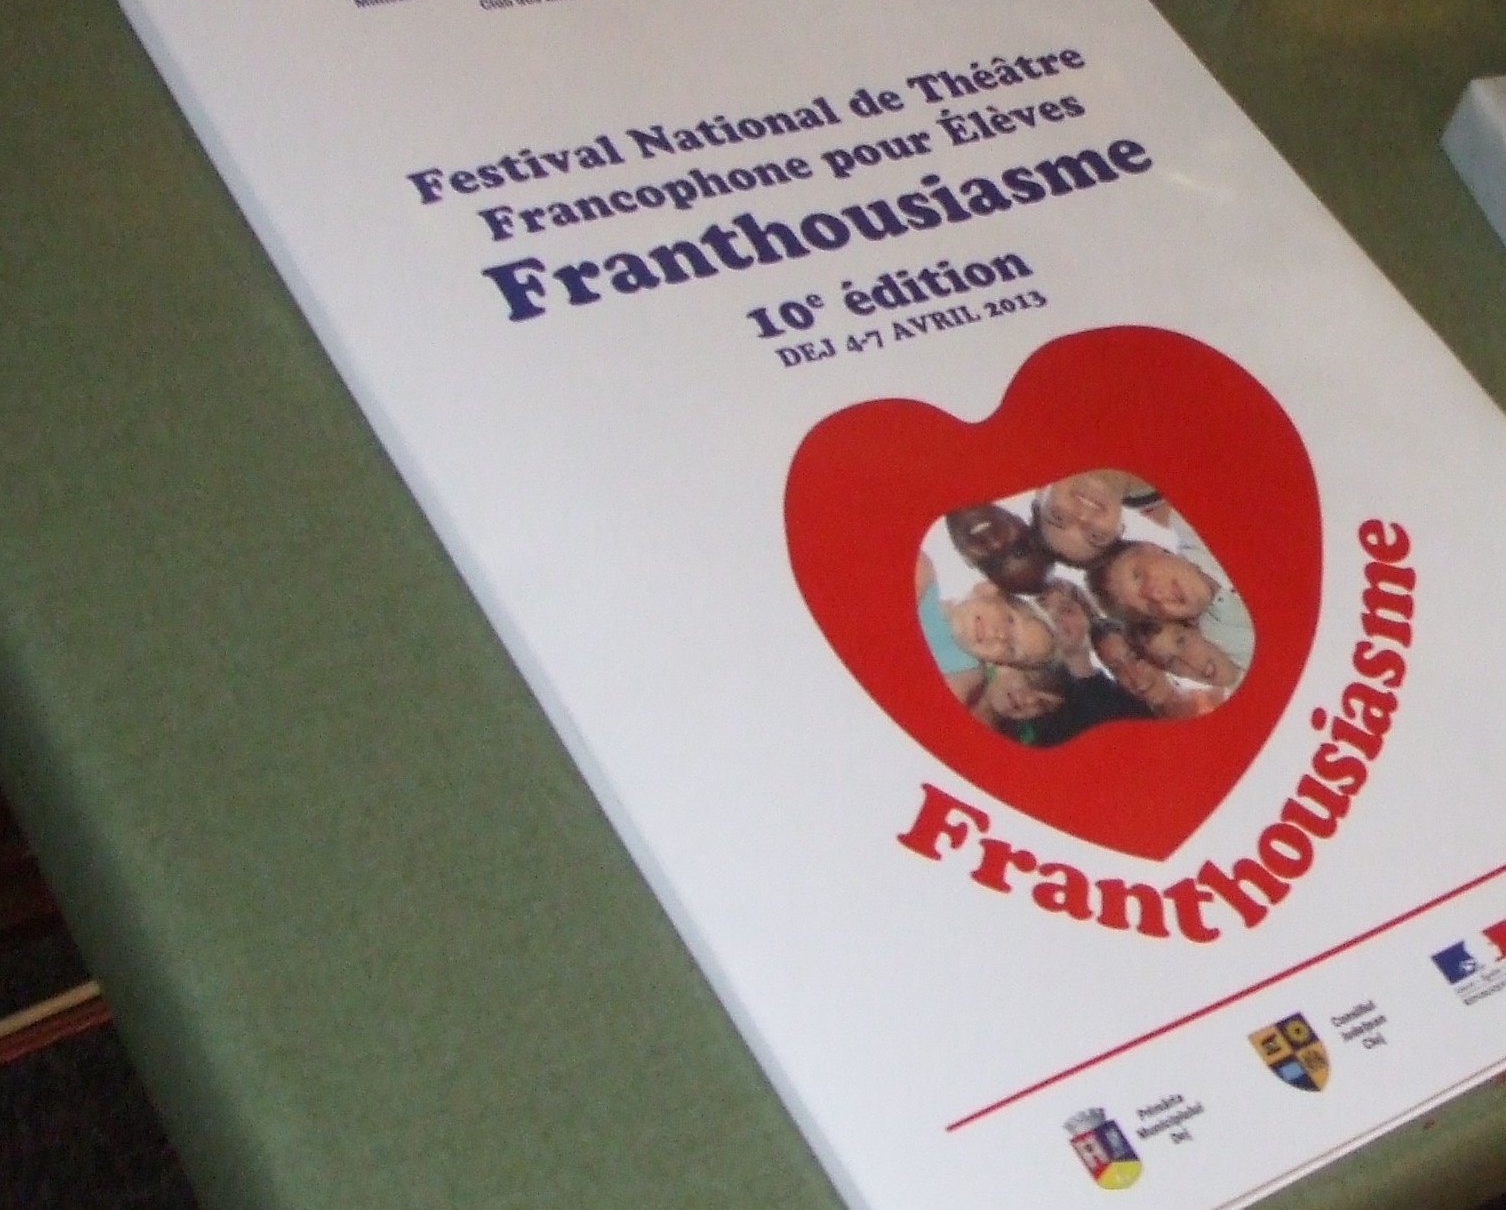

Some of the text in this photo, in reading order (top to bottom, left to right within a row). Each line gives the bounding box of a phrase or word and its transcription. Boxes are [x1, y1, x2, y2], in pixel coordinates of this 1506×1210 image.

[406, 46, 1086, 205] Festival National de Théâtre
[477, 92, 1086, 241] Francophone pour Élèves
[482, 137, 1154, 322] Franthousiasme
[843, 252, 1034, 317] édition
[777, 290, 1049, 368] DEJ 4-7 AVRIL 2013
[897, 518, 1417, 943] Franthousiasme
